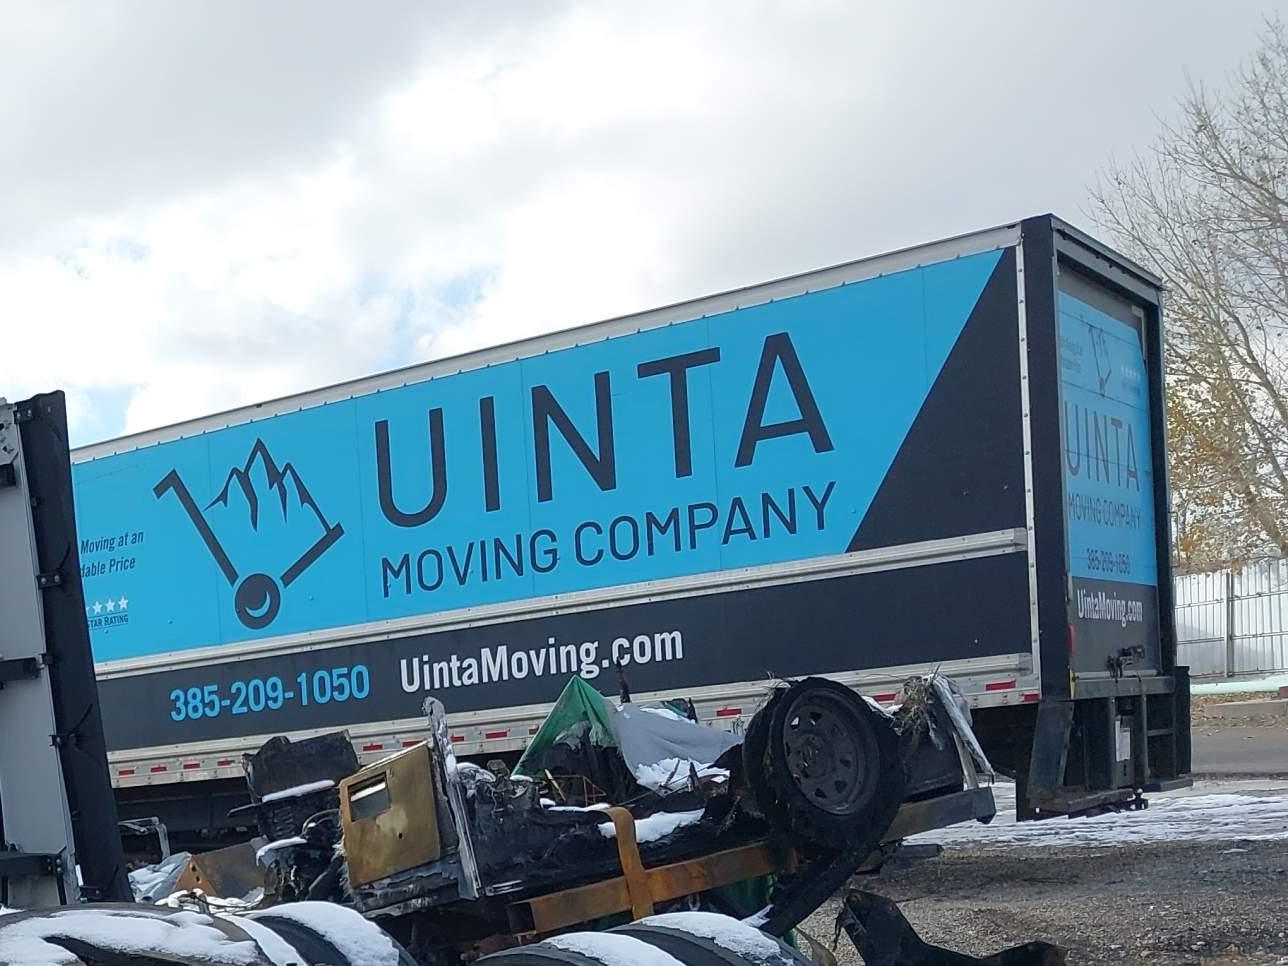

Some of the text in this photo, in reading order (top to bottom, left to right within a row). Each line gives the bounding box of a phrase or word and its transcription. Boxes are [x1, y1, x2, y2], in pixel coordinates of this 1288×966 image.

[374, 331, 835, 528] UINTA
[1064, 400, 1141, 492] UINTA
[80, 531, 144, 554] Moving at an
[109, 556, 136, 573] Price
[382, 480, 837, 598] MOVING COMPANY
[1077, 588, 1143, 627] UintaMoving.com
[169, 630, 684, 722] 385-209-1050 UintaMoving.com
